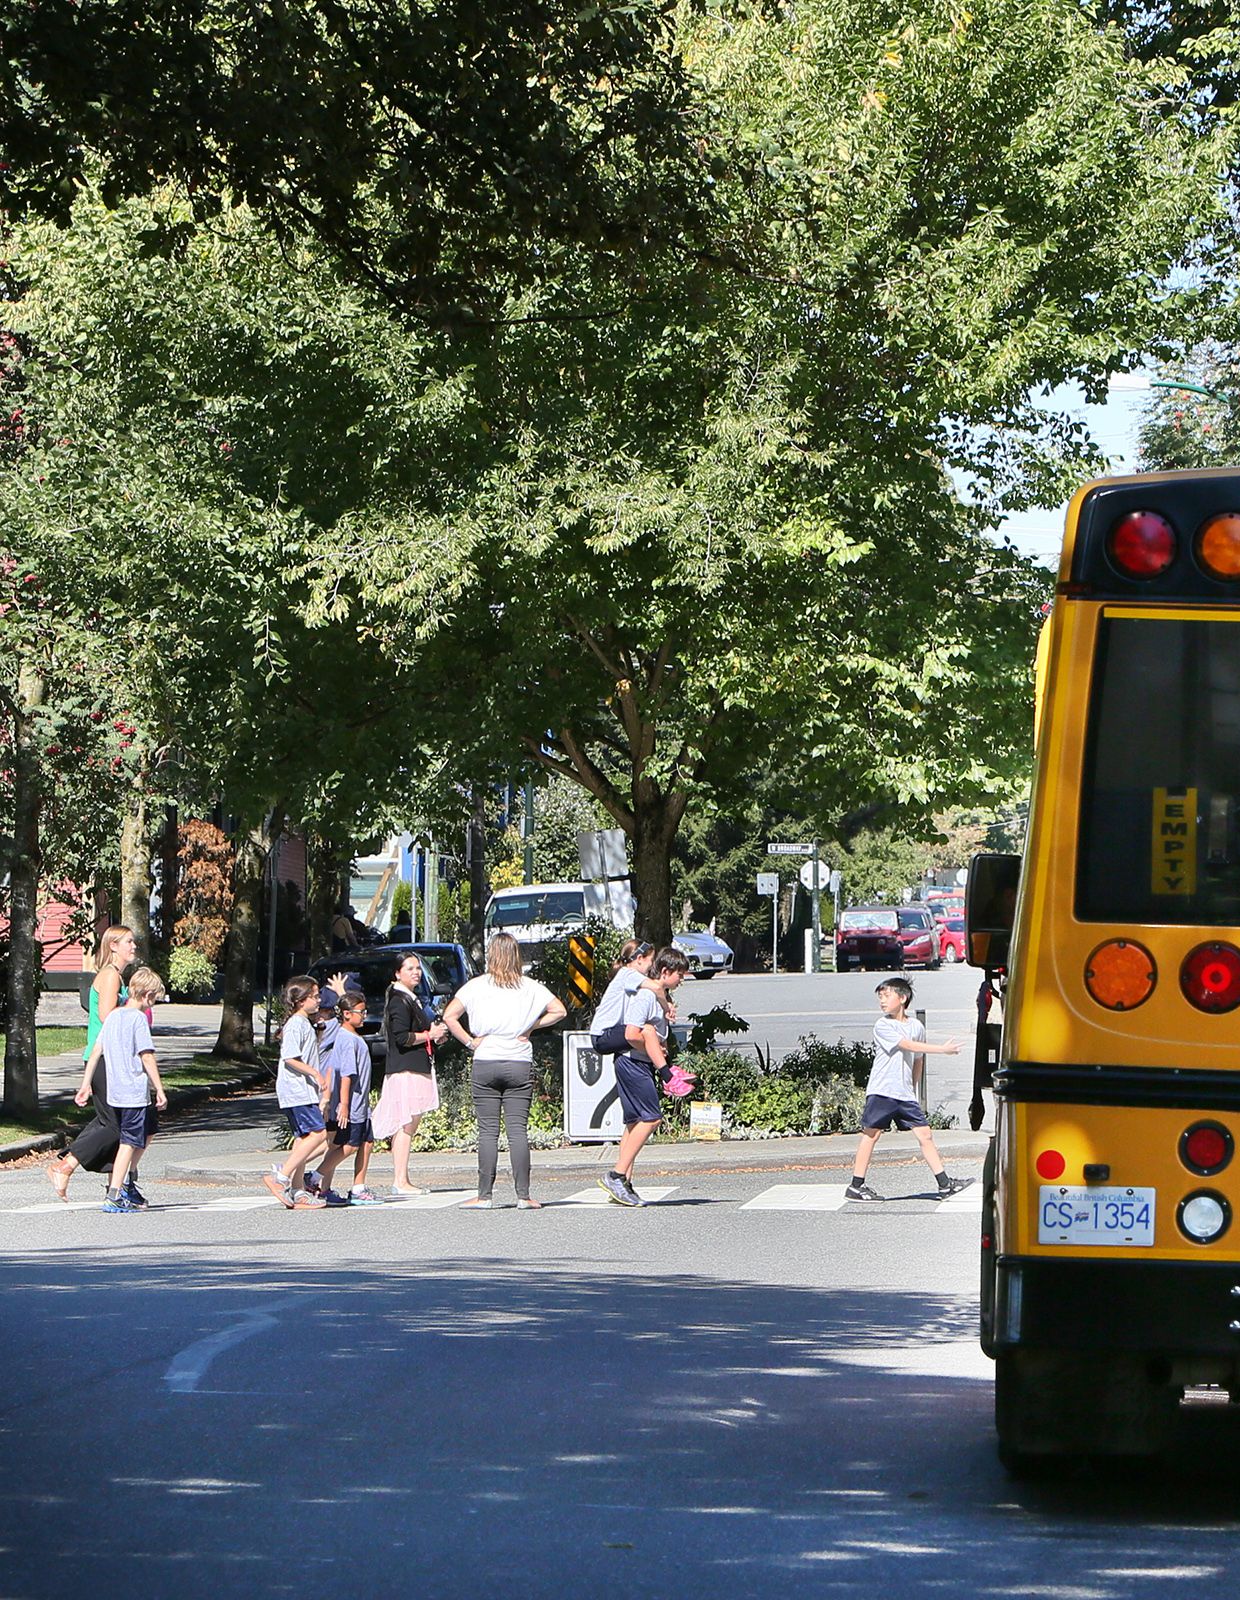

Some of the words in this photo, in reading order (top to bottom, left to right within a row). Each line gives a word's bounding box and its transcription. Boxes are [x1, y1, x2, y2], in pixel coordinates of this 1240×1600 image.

[1161, 804, 1187, 890] EMPTY
[1050, 1192, 1083, 1201] Beautiful
[1084, 1193, 1107, 1201] British
[1108, 1193, 1145, 1202] Columbia
[1093, 1202, 1150, 1230] 1354
